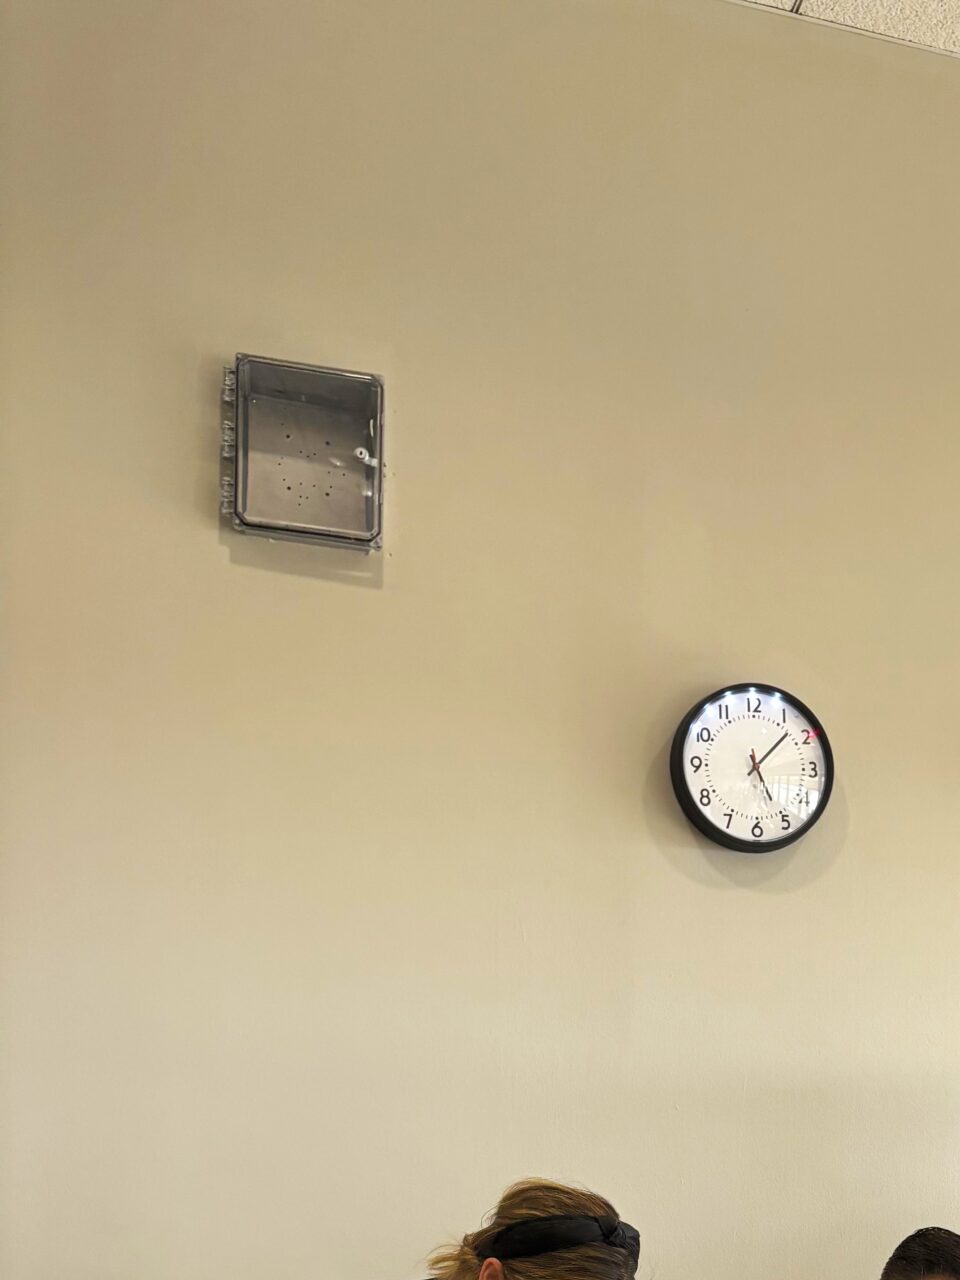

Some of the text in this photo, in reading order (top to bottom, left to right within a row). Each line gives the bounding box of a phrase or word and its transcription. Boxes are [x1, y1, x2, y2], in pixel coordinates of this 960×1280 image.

[718, 704, 729, 719] 11
[747, 697, 761, 713] 12
[782, 708, 786, 723] 1
[696, 727, 711, 743] 10
[801, 729, 811, 745] 2
[690, 755, 702, 773] 9
[808, 761, 818, 778] 3
[699, 788, 711, 806] 8
[723, 813, 733, 829] 7
[751, 820, 763, 838] 6
[781, 814, 791, 830] 5
